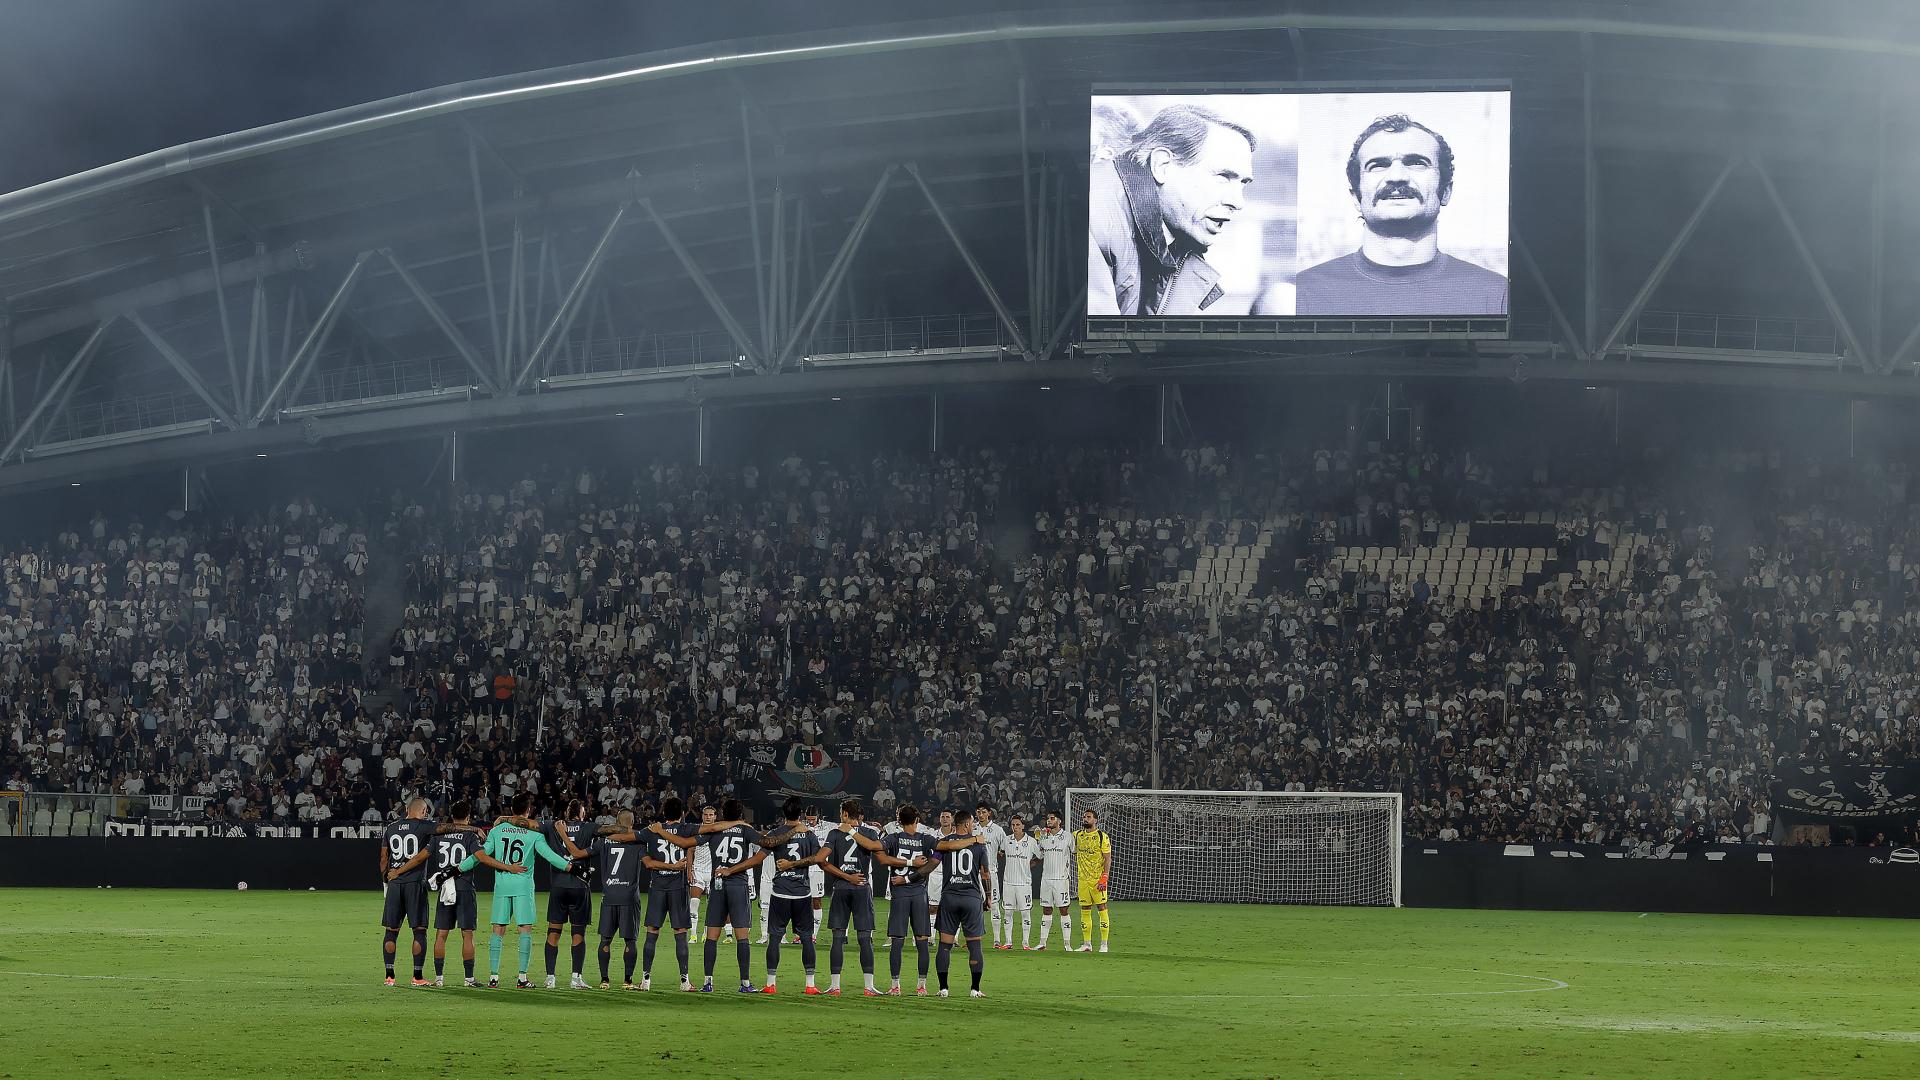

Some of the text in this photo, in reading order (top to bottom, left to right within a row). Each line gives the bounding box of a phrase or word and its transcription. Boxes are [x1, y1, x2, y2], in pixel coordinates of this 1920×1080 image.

[151, 796, 169, 807] VEC
[389, 833, 419, 861] 90
[438, 841, 467, 869] 30
[501, 837, 525, 865] 16
[715, 836, 744, 864] 45
[786, 842, 801, 861] 3
[845, 835, 858, 863] 2
[610, 847, 625, 876] 7
[951, 848, 974, 876] 10
[1060, 892, 1069, 901] 72
